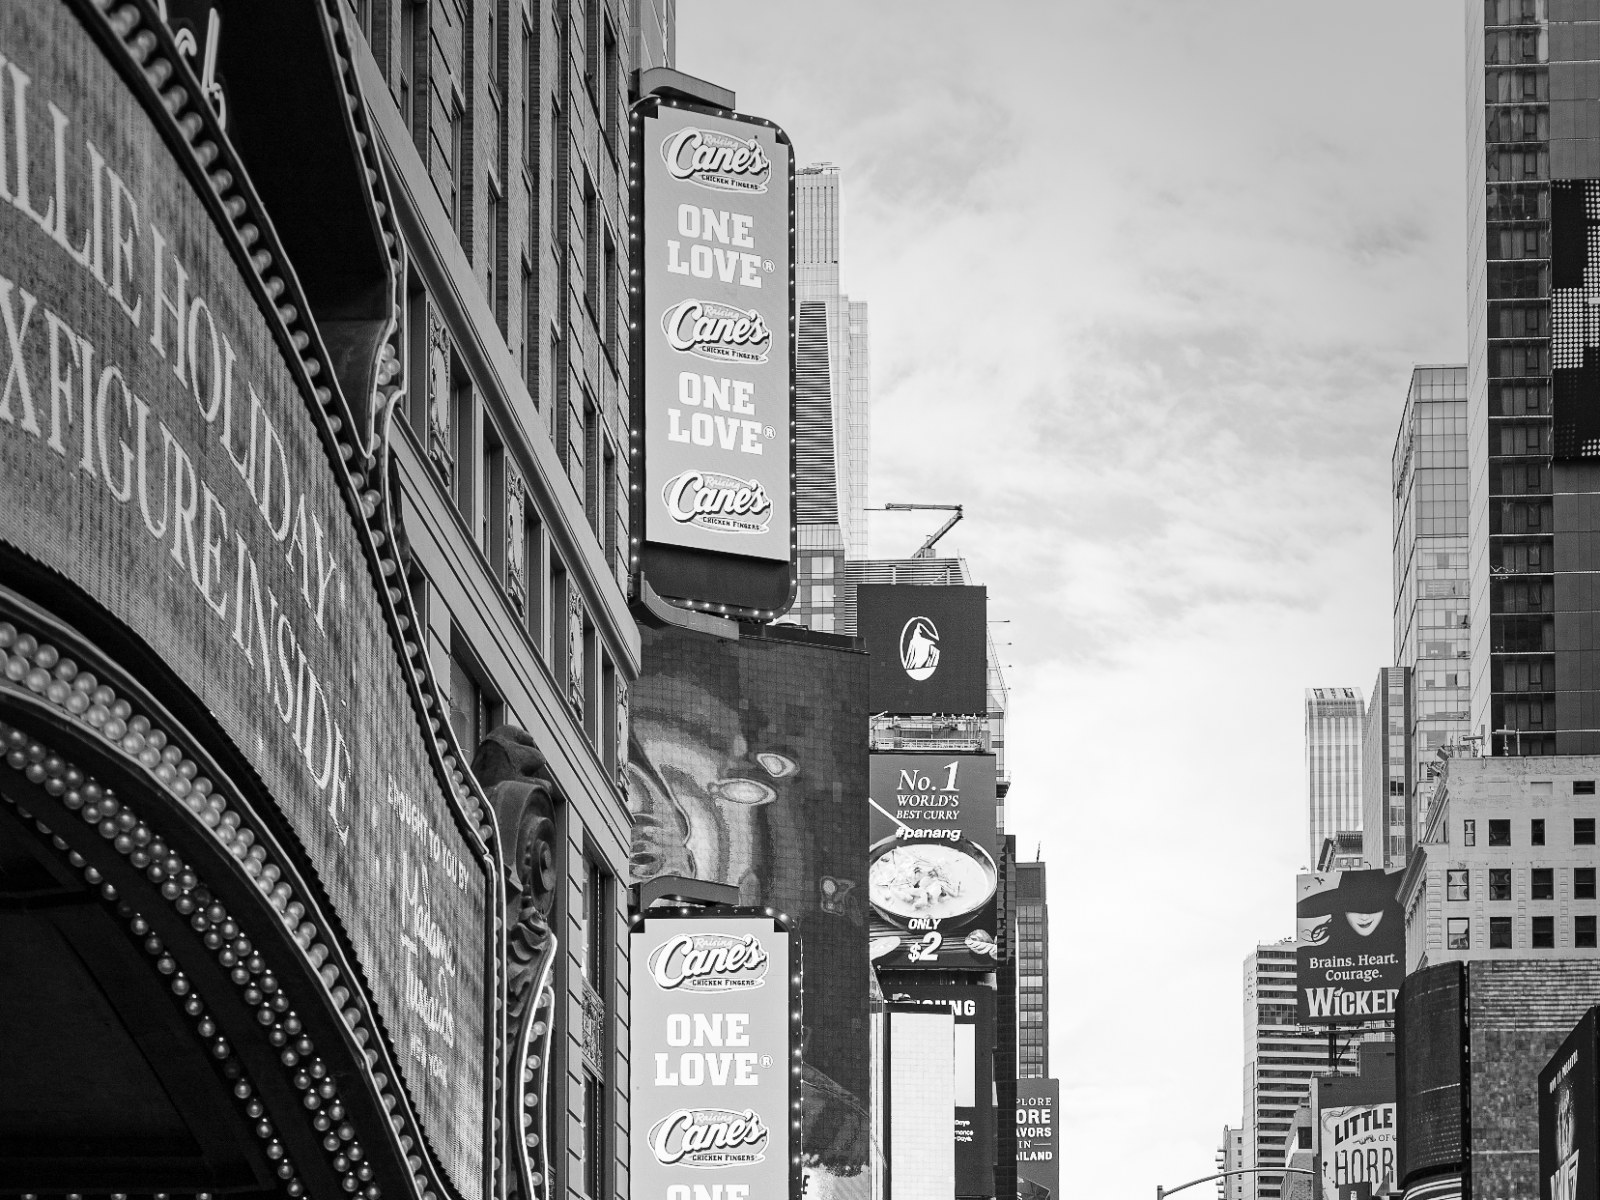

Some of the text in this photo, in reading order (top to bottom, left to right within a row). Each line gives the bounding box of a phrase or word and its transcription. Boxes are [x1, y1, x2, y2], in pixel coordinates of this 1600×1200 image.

[667, 127, 768, 179] Cane's
[701, 173, 760, 191] CHICKEN FINGERS
[678, 203, 755, 249] ONE
[667, 299, 769, 351] Cane's
[0, 50, 337, 638] LLIE HOLIDAY
[701, 345, 761, 362] CHICKEN FINGERS
[678, 371, 756, 416] ONE
[668, 469, 770, 521] Cane's
[702, 517, 761, 531] CHICKEN FINGERS
[44, 308, 228, 621] FIGURE
[231, 527, 352, 847] INSIDE
[897, 794, 960, 808] WORLD'S
[896, 809, 960, 821] BEST CURRY
[896, 827, 962, 842] #panang
[908, 917, 941, 930] ONLY
[655, 934, 767, 989] Cane's
[1309, 952, 1399, 969] Brains. Heart.
[692, 978, 755, 988] CHICKEN FINGERS
[1325, 967, 1383, 983] Courage.
[666, 1013, 750, 1047] ONE
[1334, 1107, 1393, 1146] LITTLE
[655, 1109, 767, 1164] Cane's
[1018, 1140, 1032, 1149] IN
[1379, 1133, 1391, 1142] OF
[692, 1154, 755, 1163] CHICKEN FINGERS
